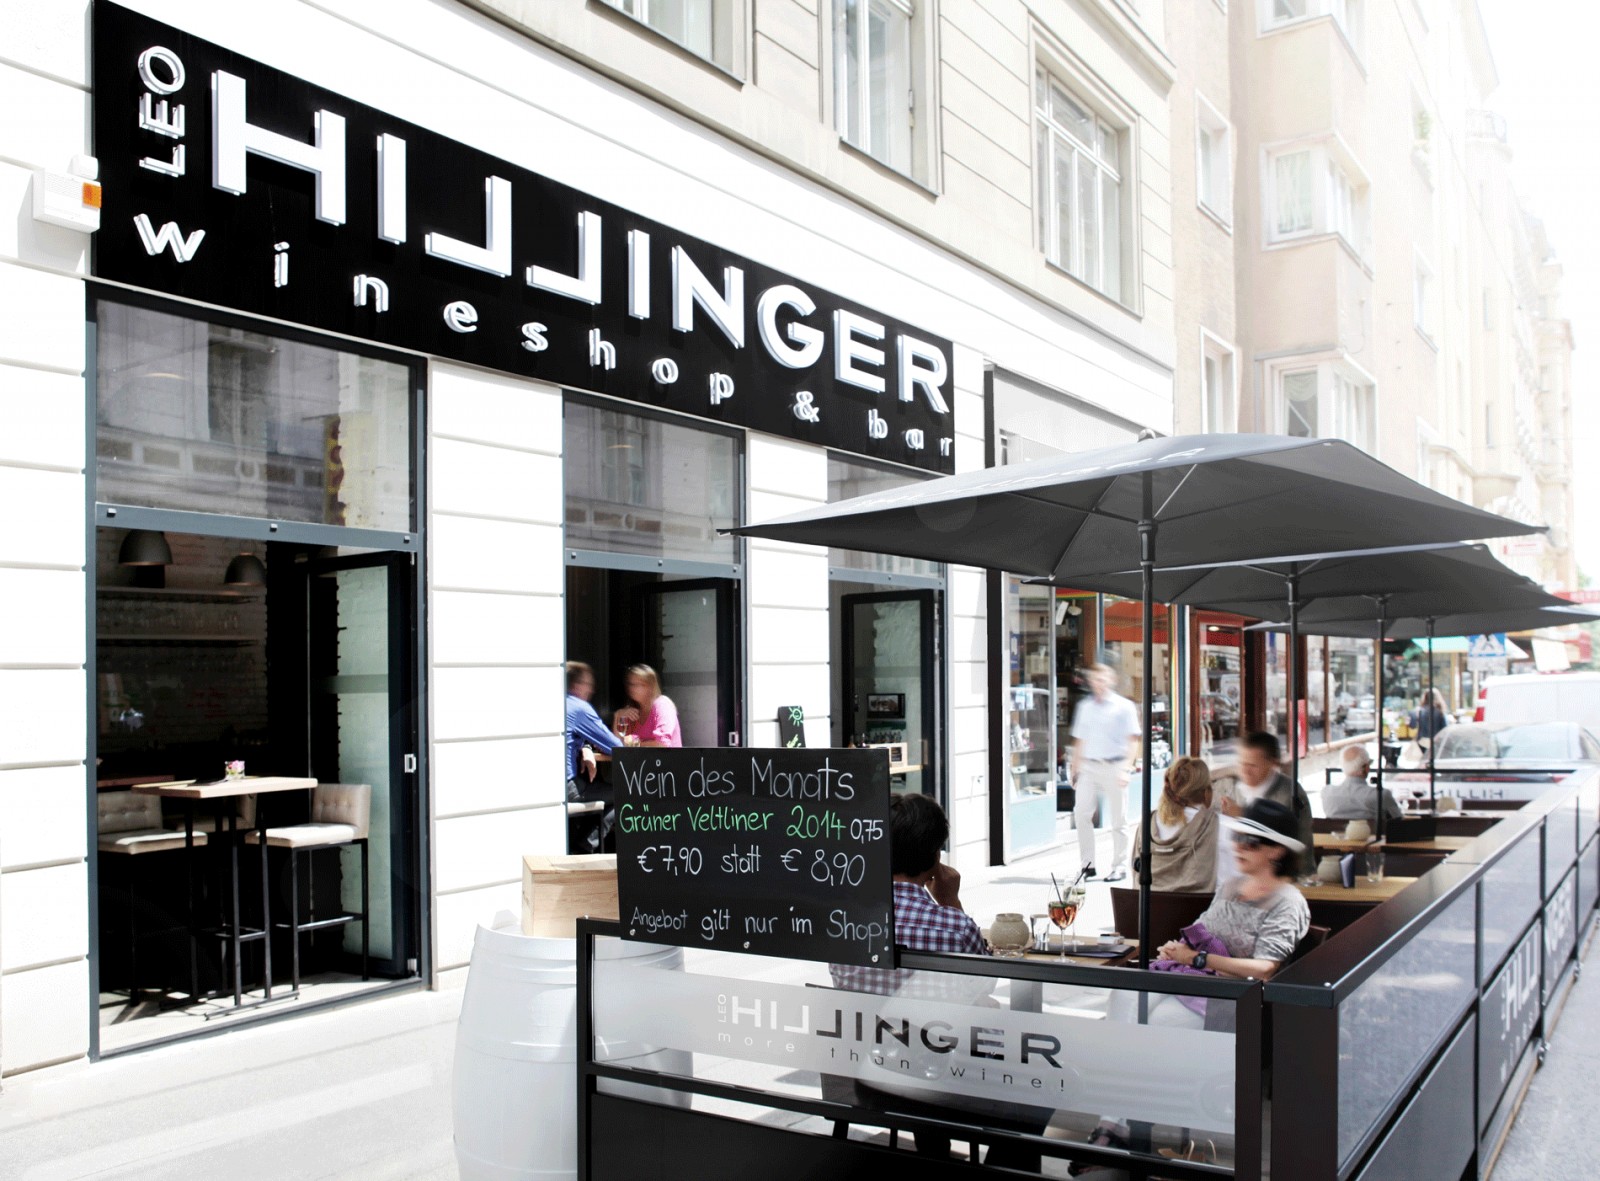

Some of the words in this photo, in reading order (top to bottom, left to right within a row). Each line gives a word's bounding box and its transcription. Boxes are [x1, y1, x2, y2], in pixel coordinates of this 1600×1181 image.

[137, 45, 186, 178] LEO
[211, 69, 949, 413] HILLINGER
[133, 213, 735, 405] wineshop
[793, 391, 820, 422] &
[868, 408, 953, 457] bar
[619, 758, 676, 799] Wein
[688, 757, 736, 798] des
[751, 756, 855, 801] Monats
[619, 803, 681, 834] Grüner
[687, 804, 774, 832] Veltliner
[786, 804, 847, 841] 2014
[720, 844, 761, 874] statt
[630, 906, 689, 934] Angebot
[701, 908, 731, 941] gilt
[744, 914, 779, 935] nur
[788, 905, 813, 936] im
[717, 993, 728, 1023] LEO
[731, 994, 1064, 1069] HILLINGER
[717, 1032, 796, 1053] more
[829, 1046, 911, 1070] than
[949, 1066, 1066, 1092] wine!
